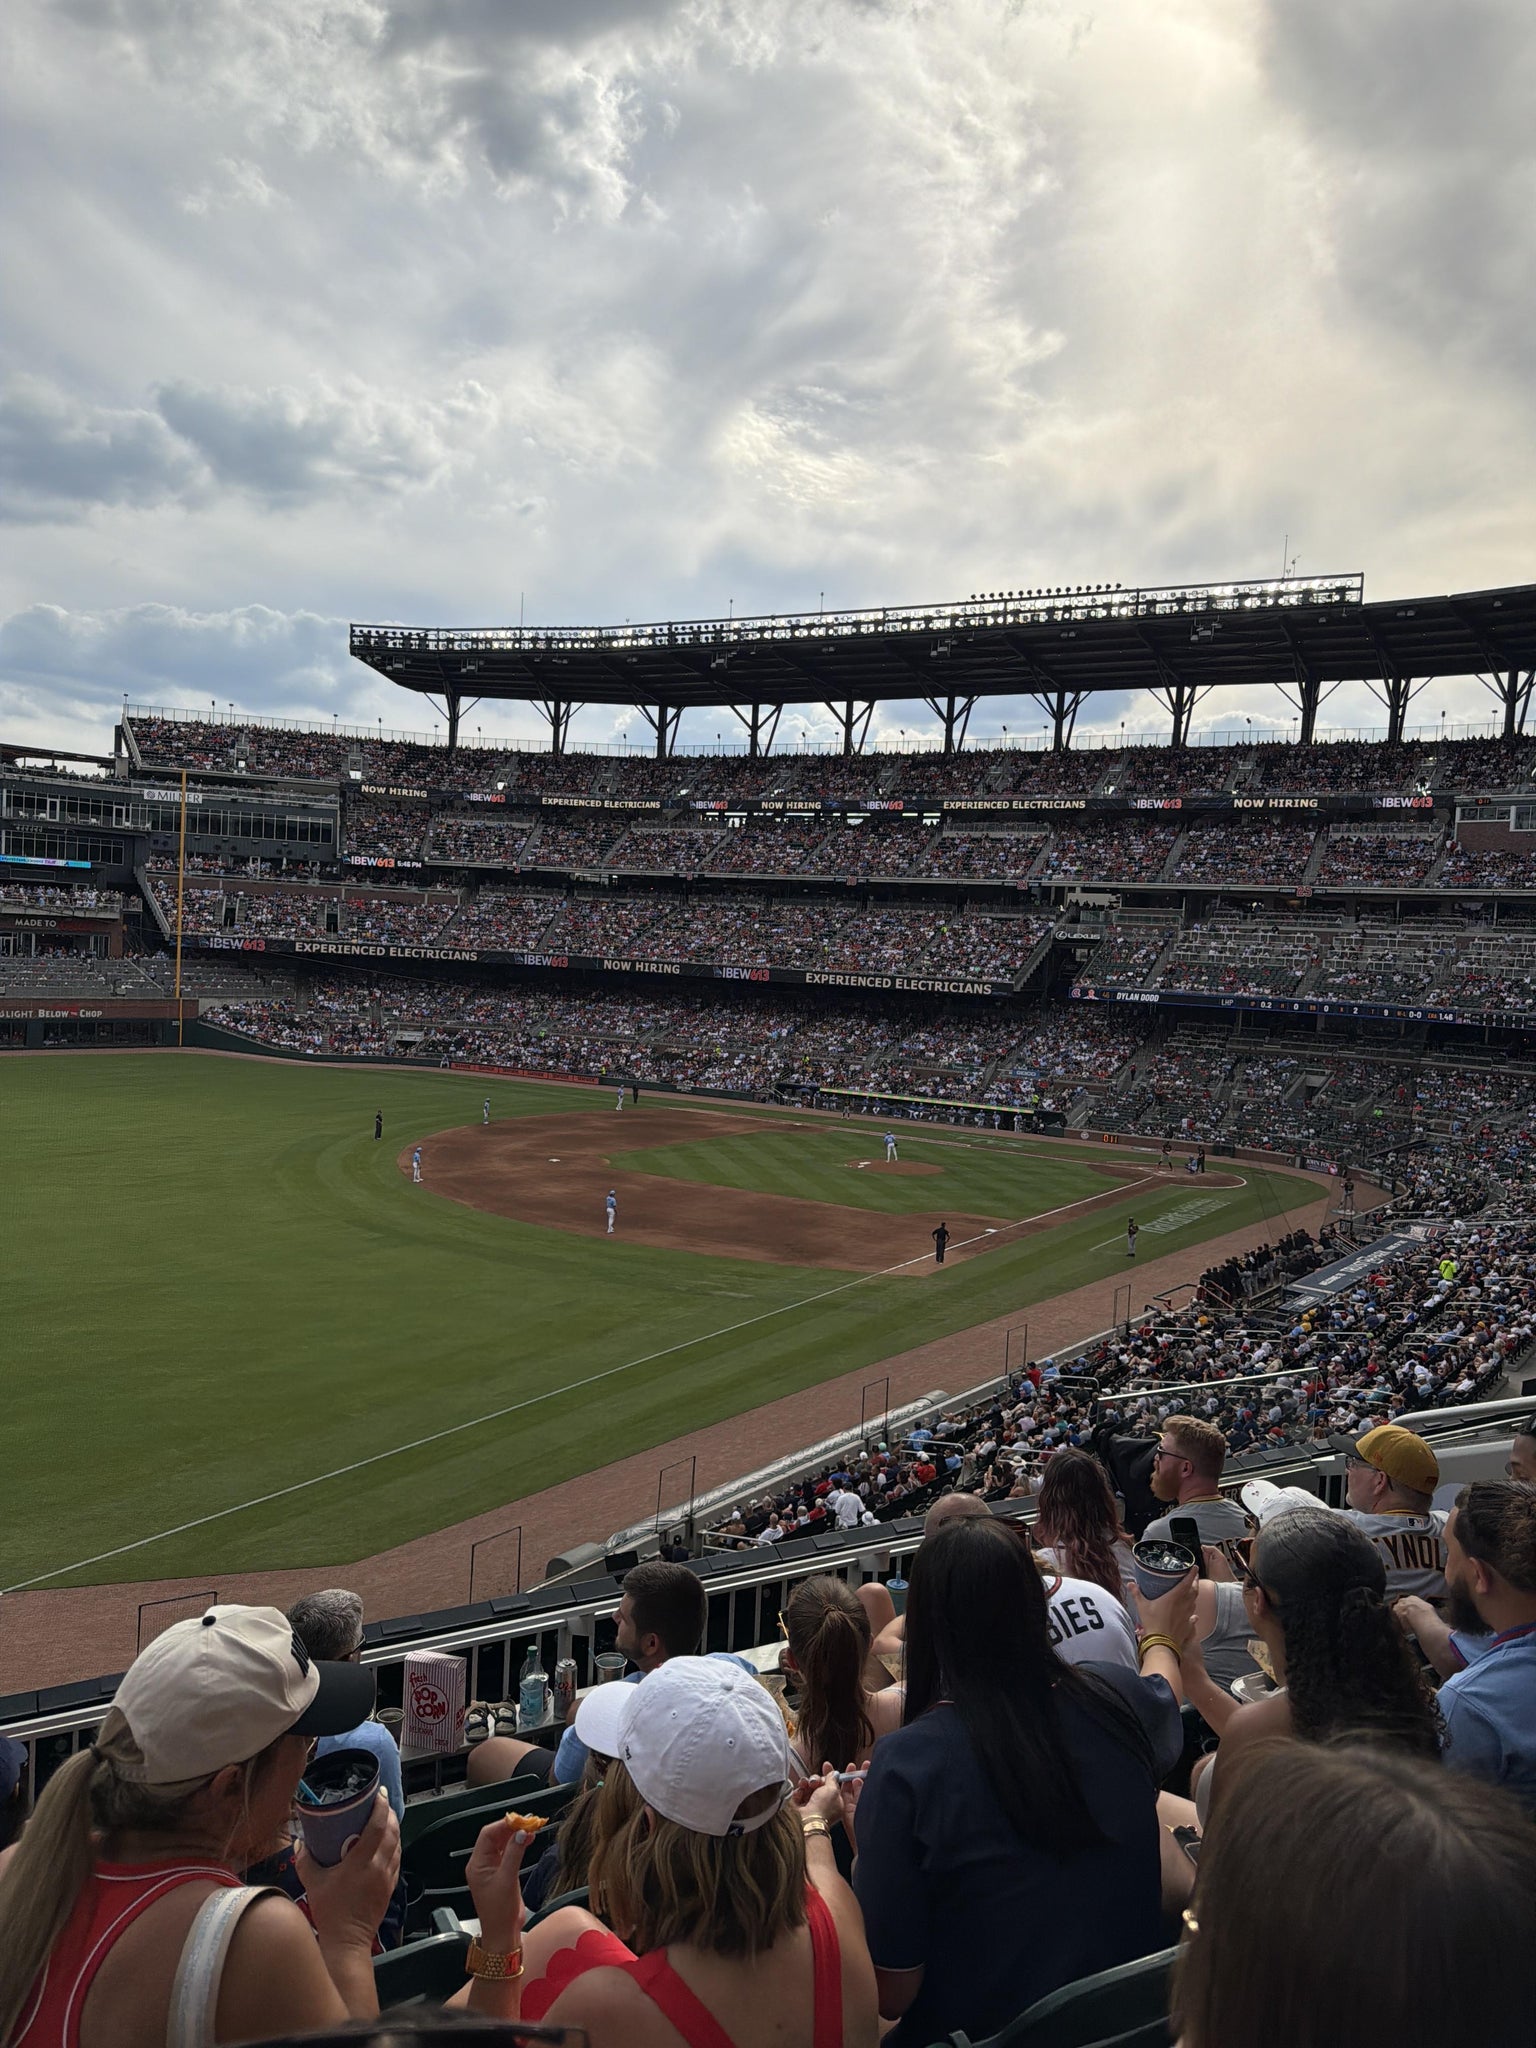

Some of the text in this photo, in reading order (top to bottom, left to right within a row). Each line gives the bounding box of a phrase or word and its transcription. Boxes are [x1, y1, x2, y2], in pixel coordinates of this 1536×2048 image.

[361, 785, 428, 798] NOW HIRING
[542, 797, 661, 809] EXPERIENCED ELECTRICIANS
[761, 802, 822, 810] NOW HIRING
[943, 800, 1086, 809] EXPERIENCED ELECTRICIANS
[1233, 799, 1318, 808] NOW HIRING
[15, 919, 42, 927] MADE
[45, 920, 56, 928] TO
[295, 942, 478, 961] EXPERIENCED ELECTRICIANS
[603, 960, 681, 975] NOW HIRING
[805, 972, 992, 995] EXPERIENCED ELECTRICIANS
[1116, 992, 1139, 1001] DYLAN
[1221, 998, 1234, 1006] LHP
[1260, 1001, 1272, 1009] 0.2
[1409, 1011, 1422, 1019] 0-0
[1372, 1535, 1446, 1573] YNOL
[414, 1687, 438, 1704] POP
[416, 1701, 446, 1719] CORN
